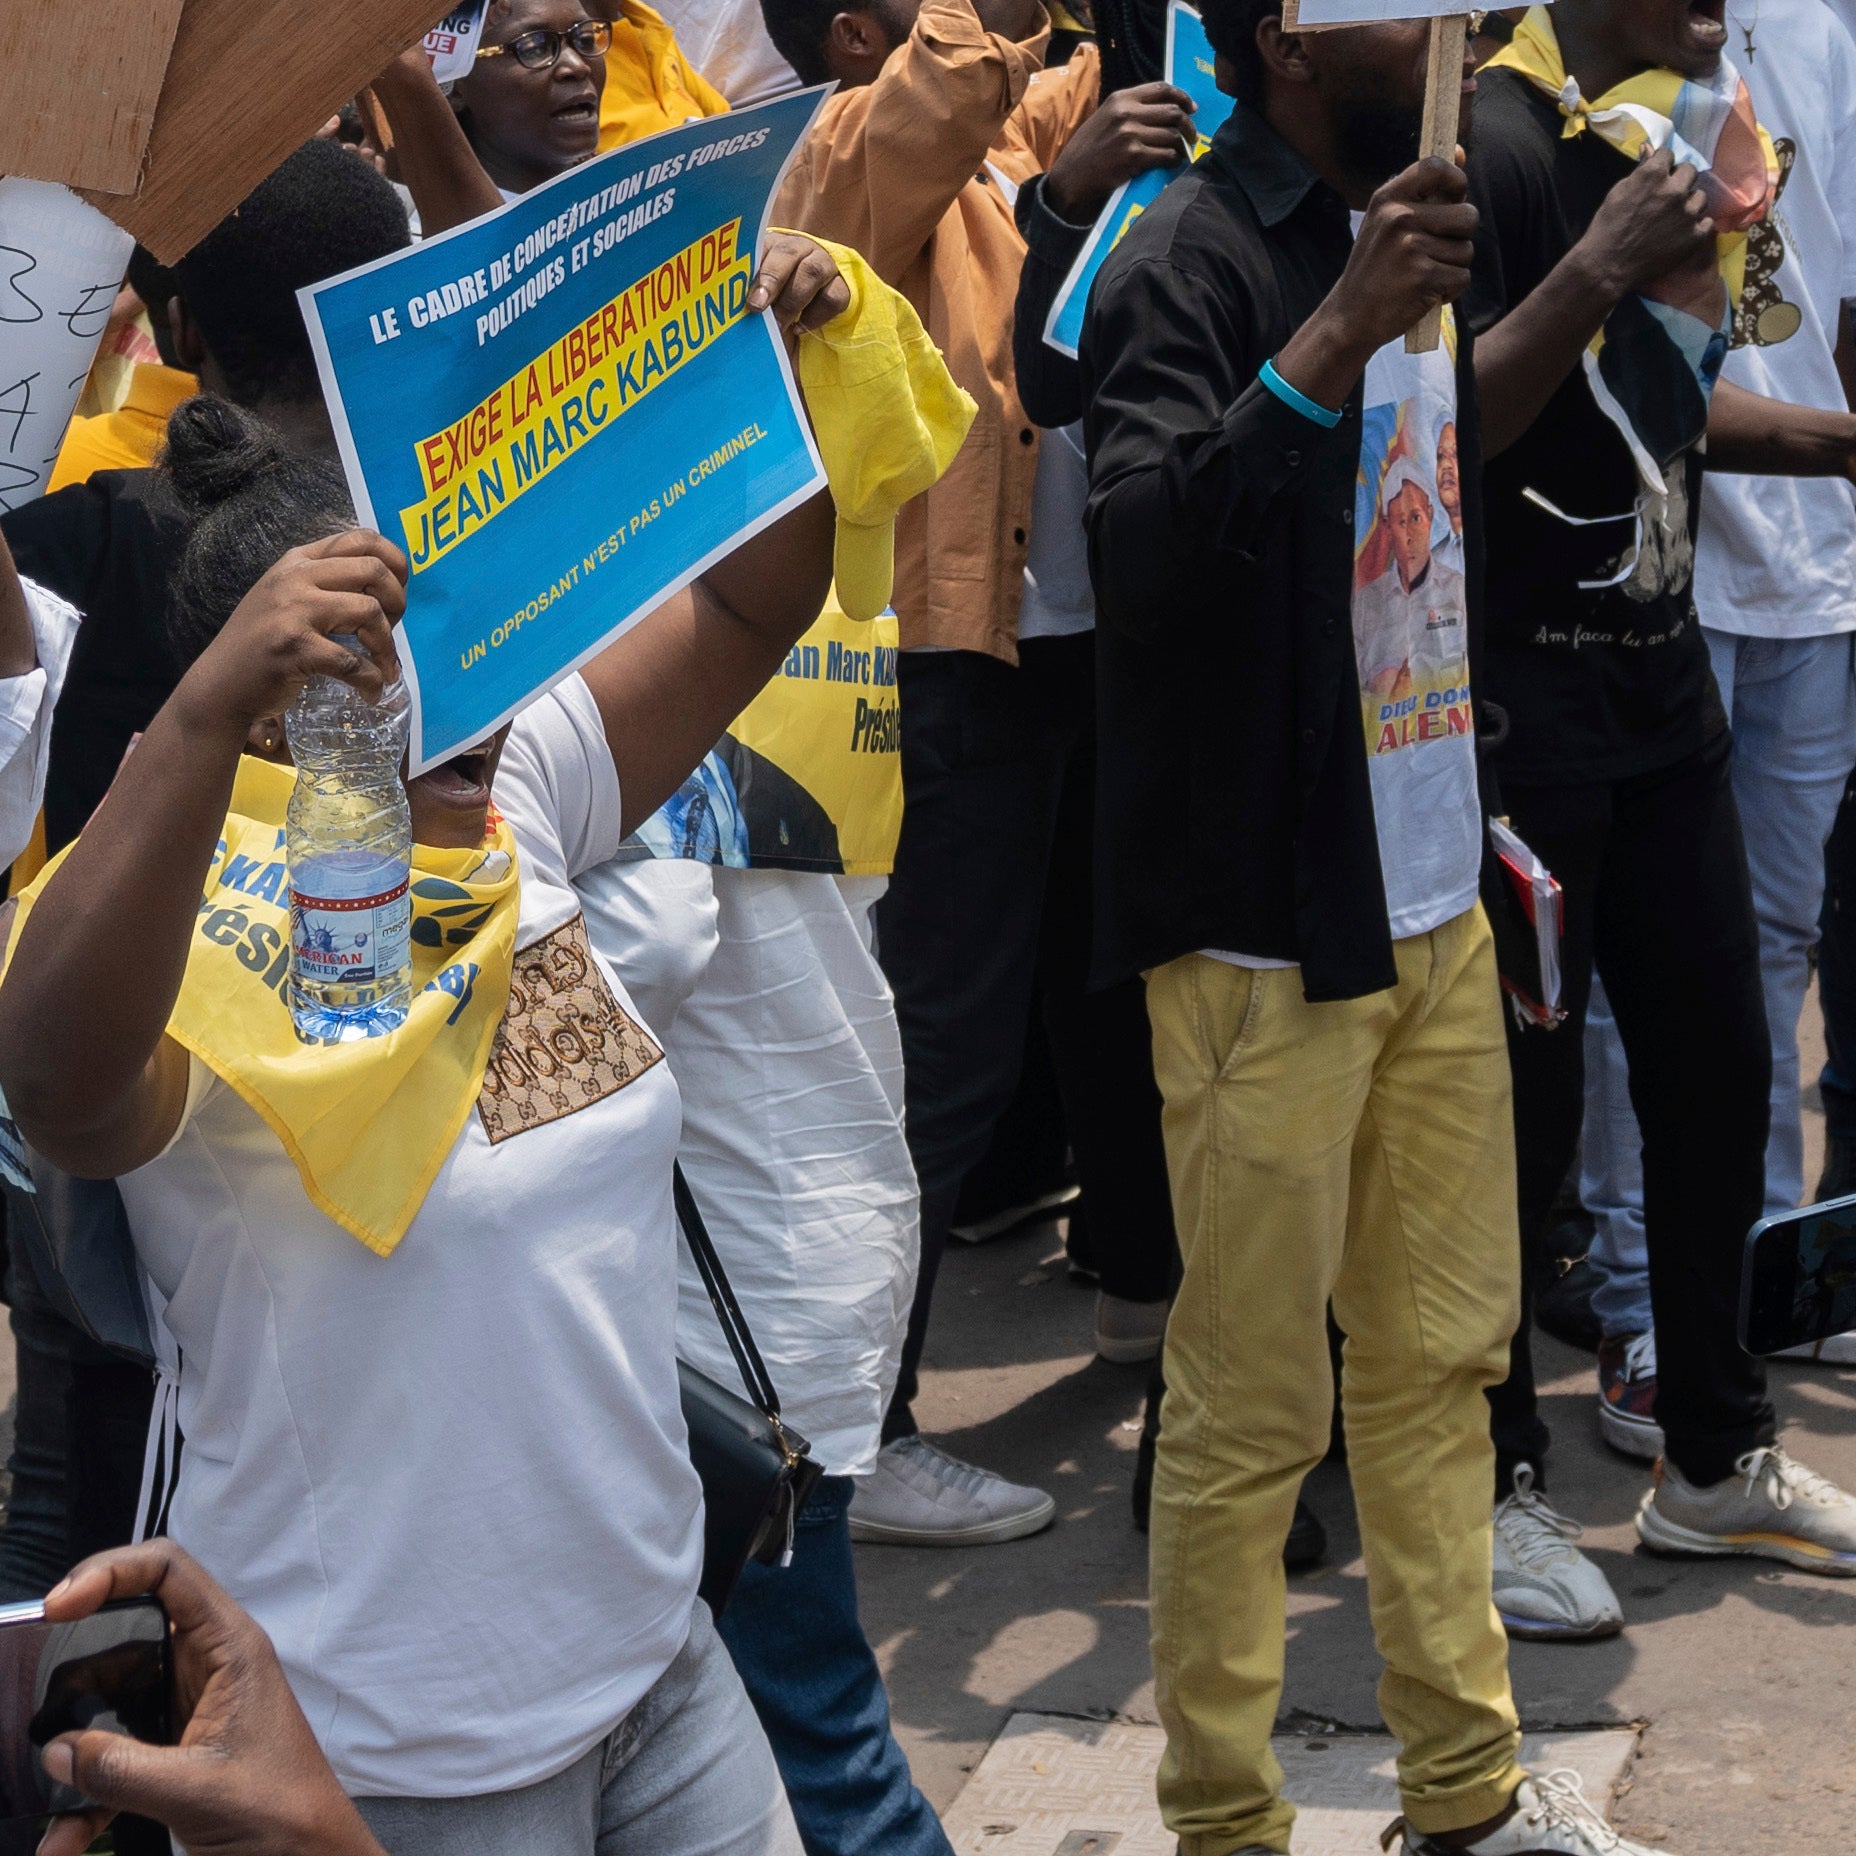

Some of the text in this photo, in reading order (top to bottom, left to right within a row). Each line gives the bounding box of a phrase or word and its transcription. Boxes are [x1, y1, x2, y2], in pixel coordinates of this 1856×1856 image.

[368, 127, 770, 345] LE CADRE DE CONCERTATION DES FORCES
[477, 188, 676, 347] POLITIQUES ET SOCIALES
[423, 220, 740, 493] EXIGE LA LIBERATION DE
[411, 465, 507, 567] JEAN
[515, 384, 609, 490] MARC
[460, 422, 769, 670] UN OPPOSANT N'EST PAS UN CRIMINEL
[826, 641, 870, 685] Marc
[1380, 696, 1418, 721] DIEU
[302, 961, 339, 975] WATER
